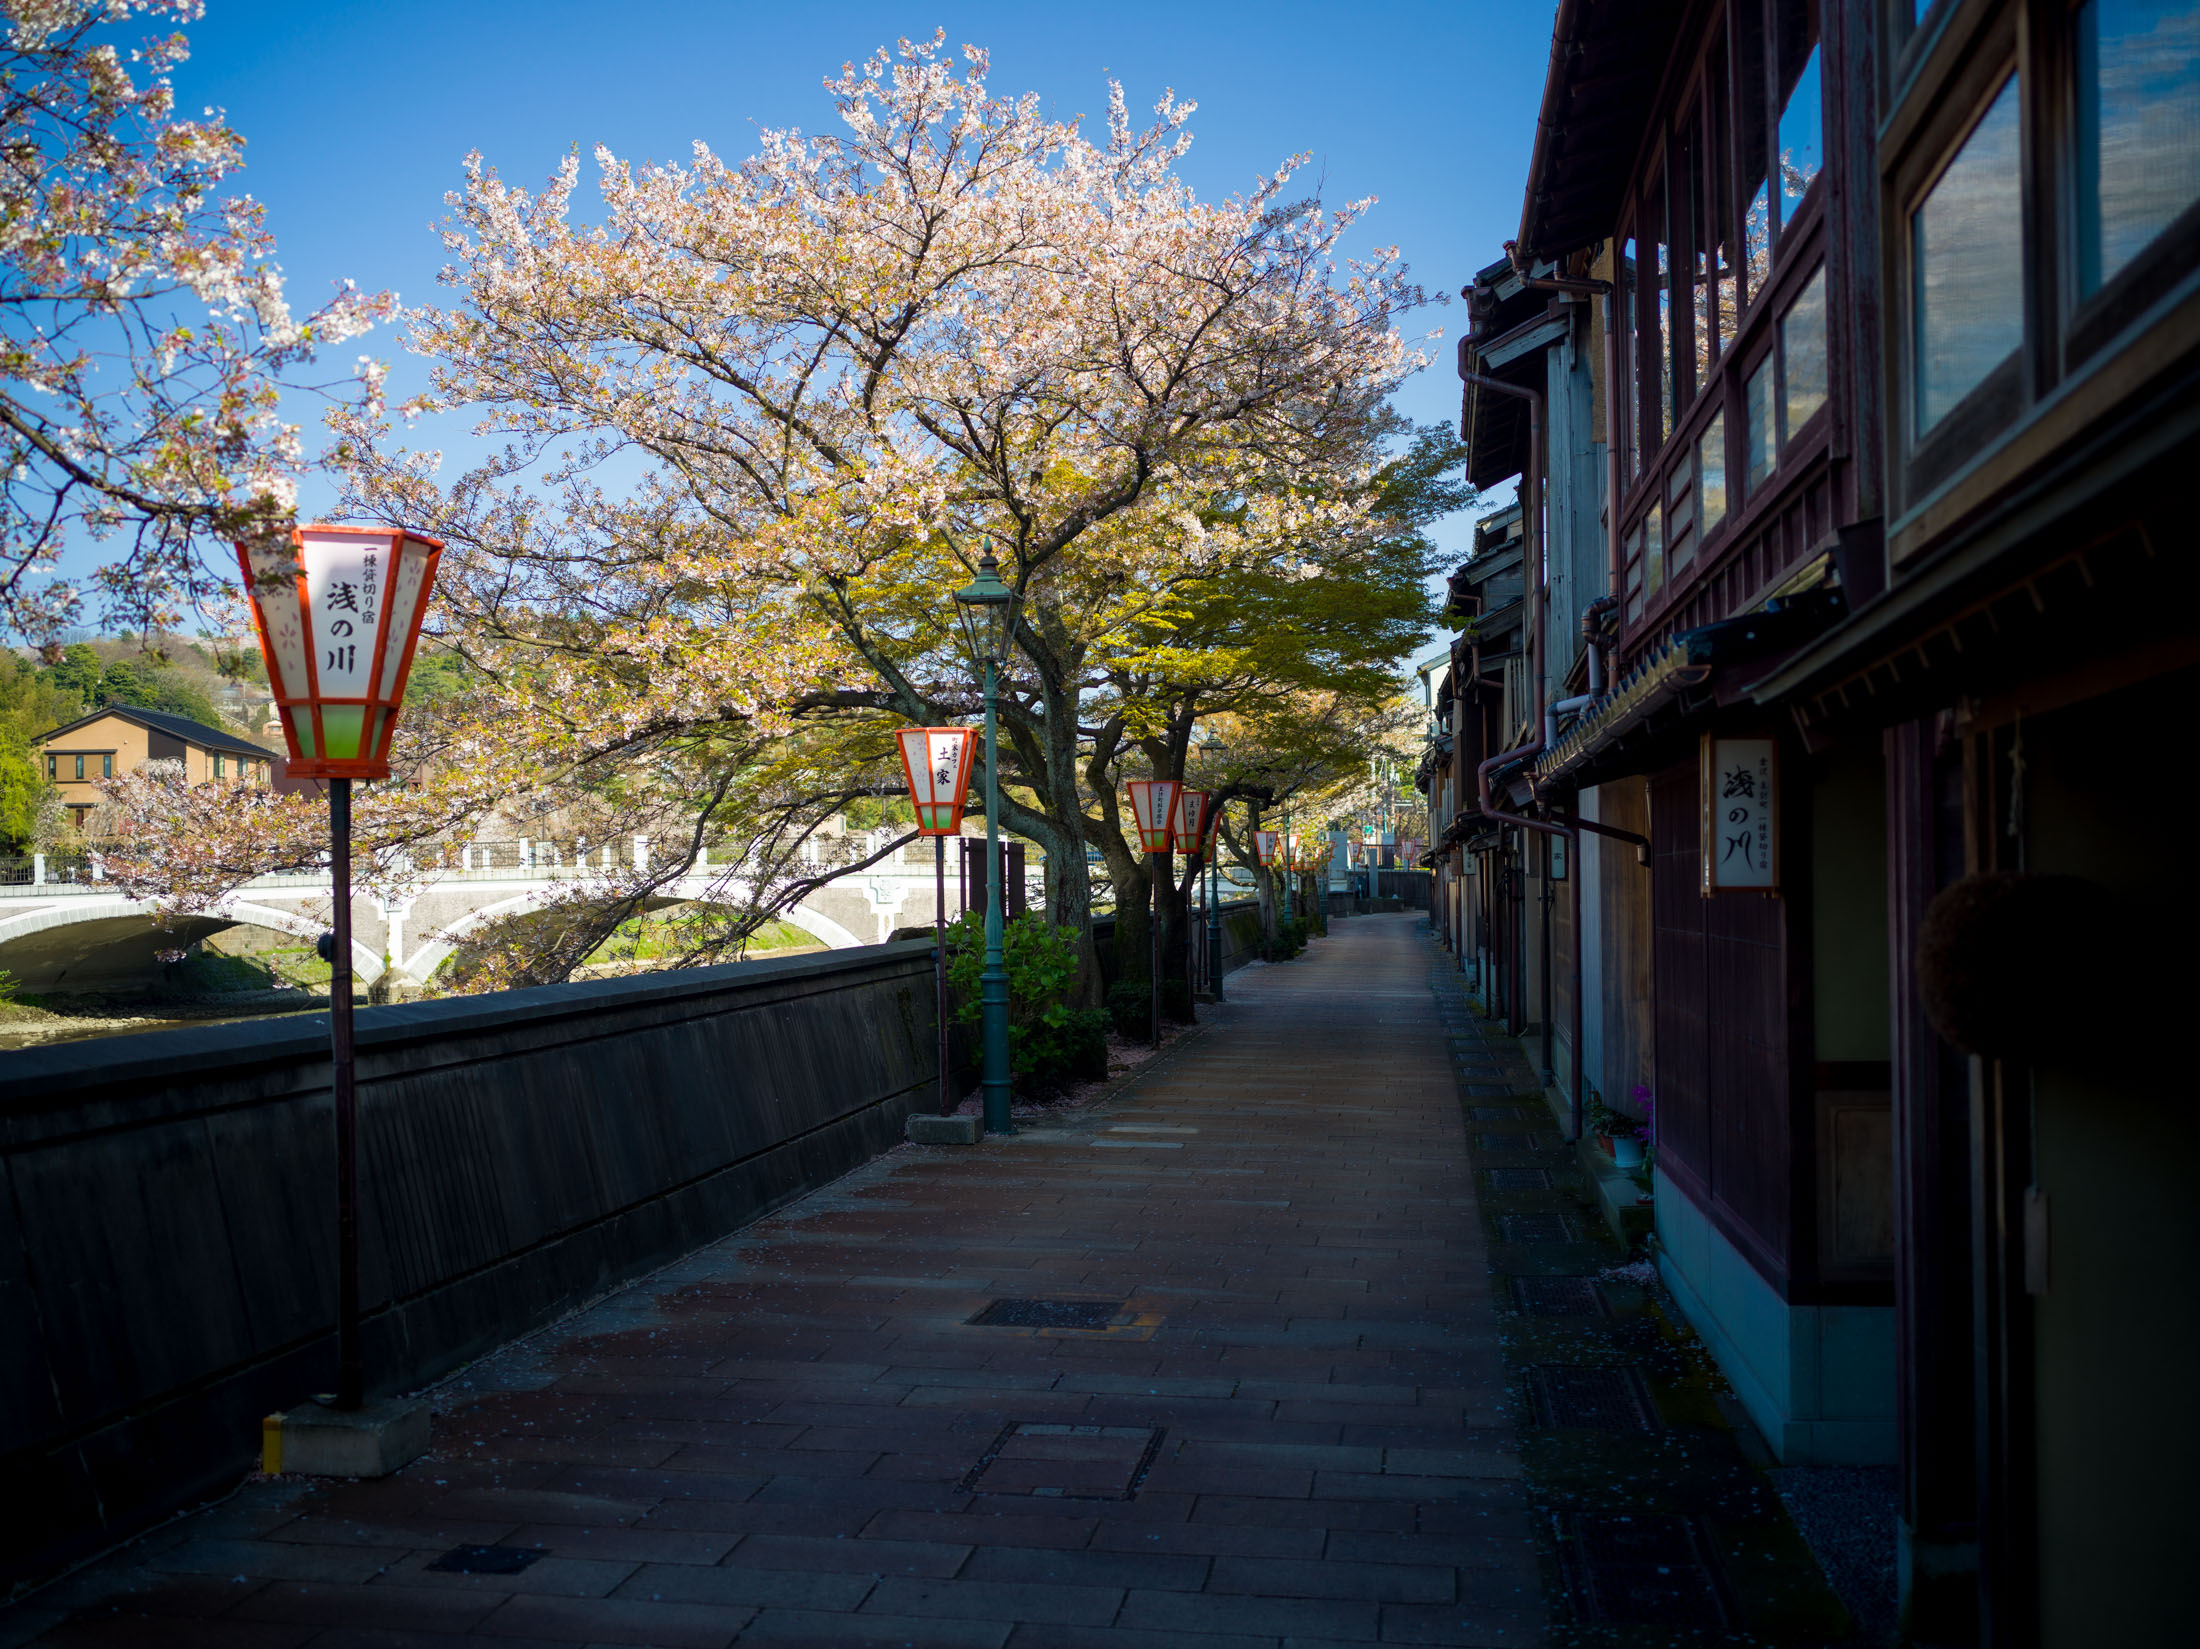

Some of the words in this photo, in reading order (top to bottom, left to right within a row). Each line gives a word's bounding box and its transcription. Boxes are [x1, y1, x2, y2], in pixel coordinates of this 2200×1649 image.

[361, 547, 378, 625] 一棟貸切り宿
[326, 581, 359, 675] 浅の川
[936, 747, 950, 786] 土家
[951, 737, 959, 768] 町家カフェ
[1722, 764, 1756, 874] 浅の川
